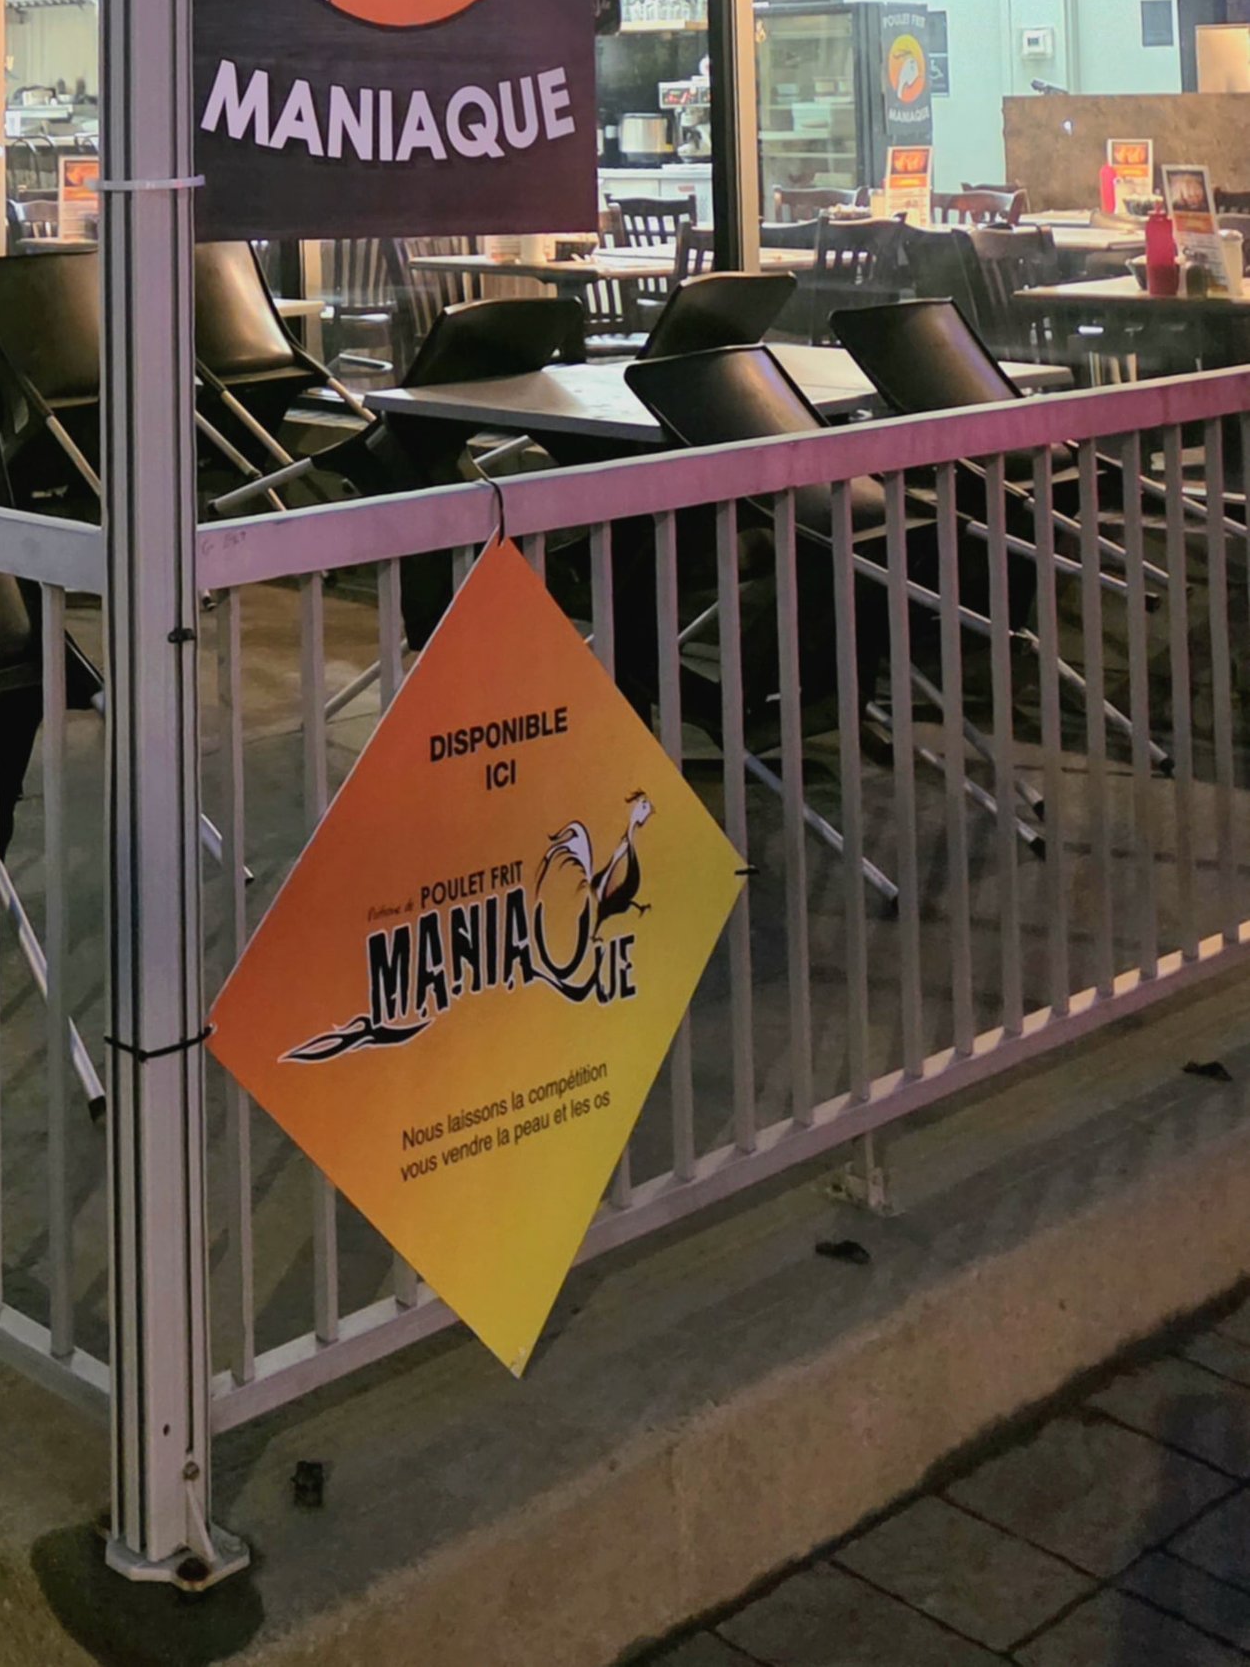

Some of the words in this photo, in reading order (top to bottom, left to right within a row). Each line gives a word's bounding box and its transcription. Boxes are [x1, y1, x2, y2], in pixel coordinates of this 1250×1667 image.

[200, 58, 578, 164] MANIAQUE
[889, 105, 930, 123] MANIAQUE
[430, 706, 568, 762] DISPONIBLE
[486, 759, 516, 790] ICI
[420, 870, 485, 909] POULET
[491, 860, 523, 889] FRIT
[368, 887, 637, 1029] MANIAQUE
[400, 1154, 438, 1182] vous
[441, 1134, 493, 1166] vendre
[497, 1127, 510, 1147] la
[514, 1113, 550, 1145] peau
[553, 1103, 568, 1125] et
[571, 1097, 591, 1119] les
[593, 1090, 611, 1110] os
[402, 1121, 444, 1150] Nous
[447, 1098, 508, 1134] laissons
[511, 1091, 525, 1111] la
[528, 1062, 608, 1105] compétition
